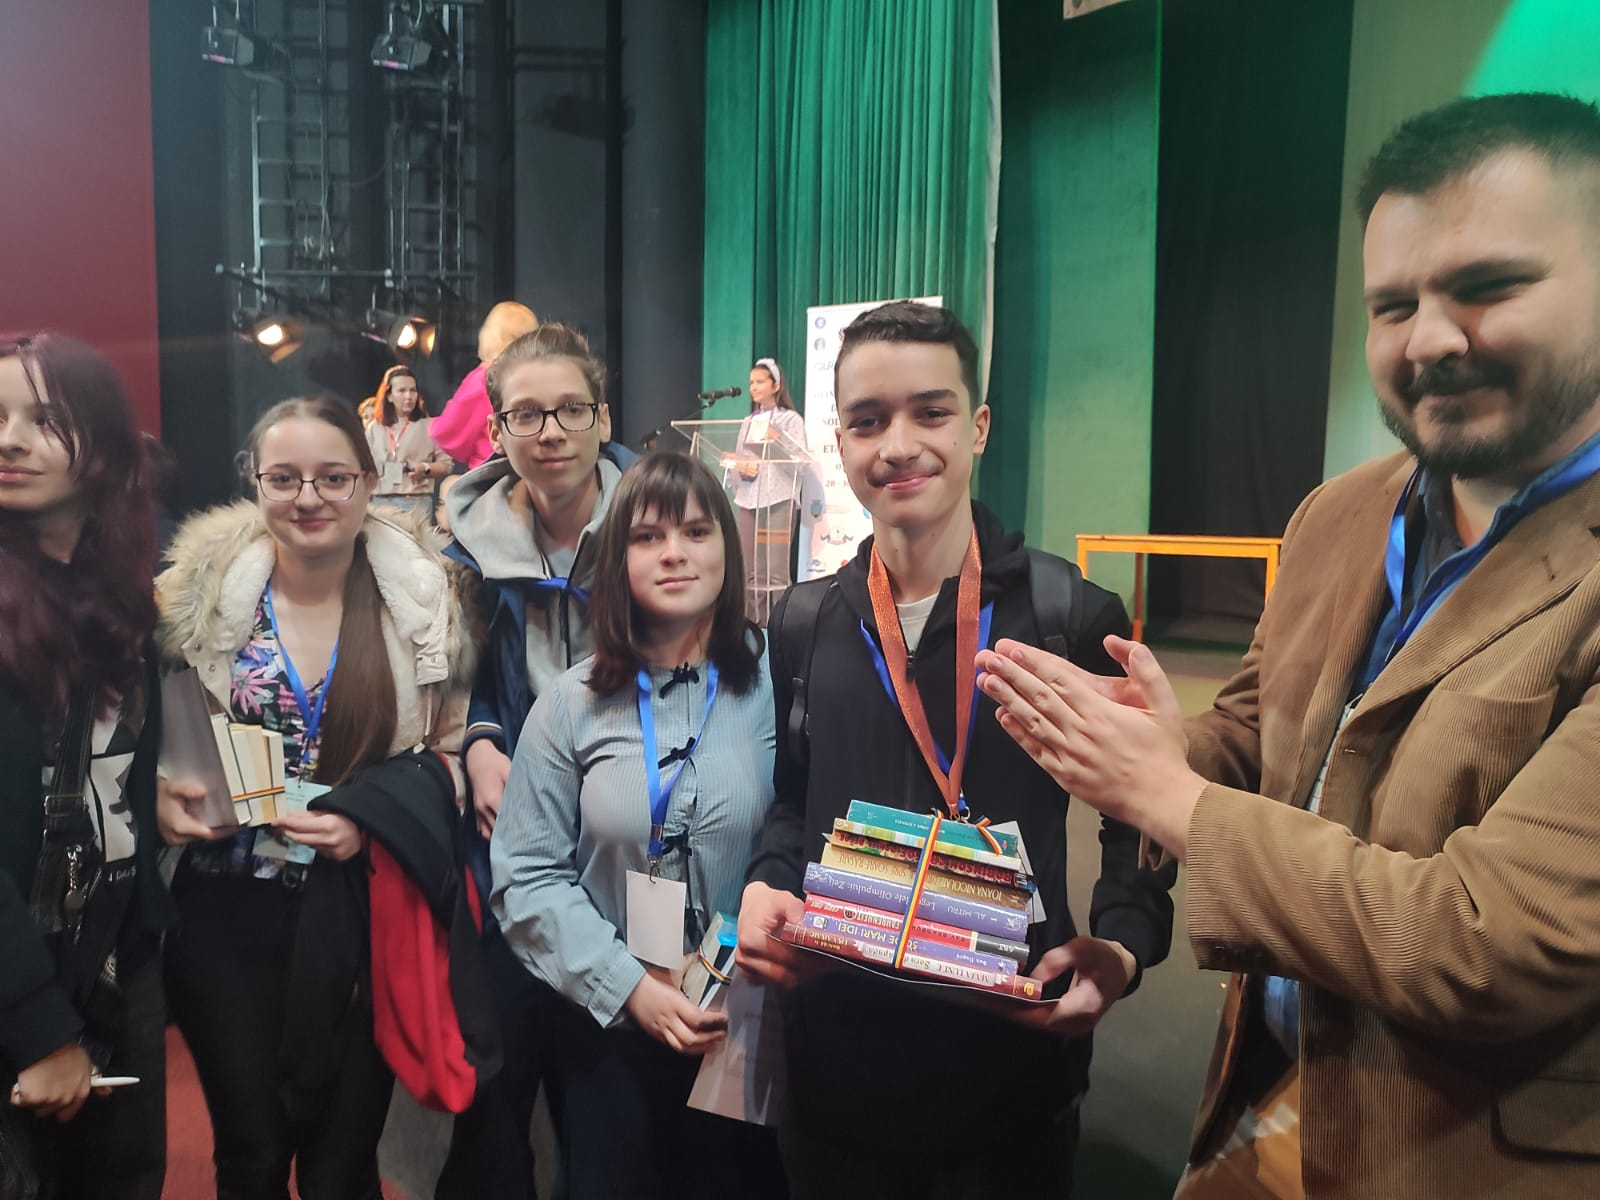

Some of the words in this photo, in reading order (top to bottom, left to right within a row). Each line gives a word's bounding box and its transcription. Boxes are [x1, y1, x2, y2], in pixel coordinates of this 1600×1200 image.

[900, 848, 946, 868] CRSOE
[948, 860, 1011, 884] ROBINSON
[847, 882, 893, 900] Olimpului:
[977, 886, 1002, 900] IOANA
[894, 892, 936, 910] Legele
[946, 905, 972, 916] MITRU
[856, 912, 900, 930] FAHRENHEIT
[860, 928, 886, 943] MARI
[911, 926, 947, 938] BRADBUR
